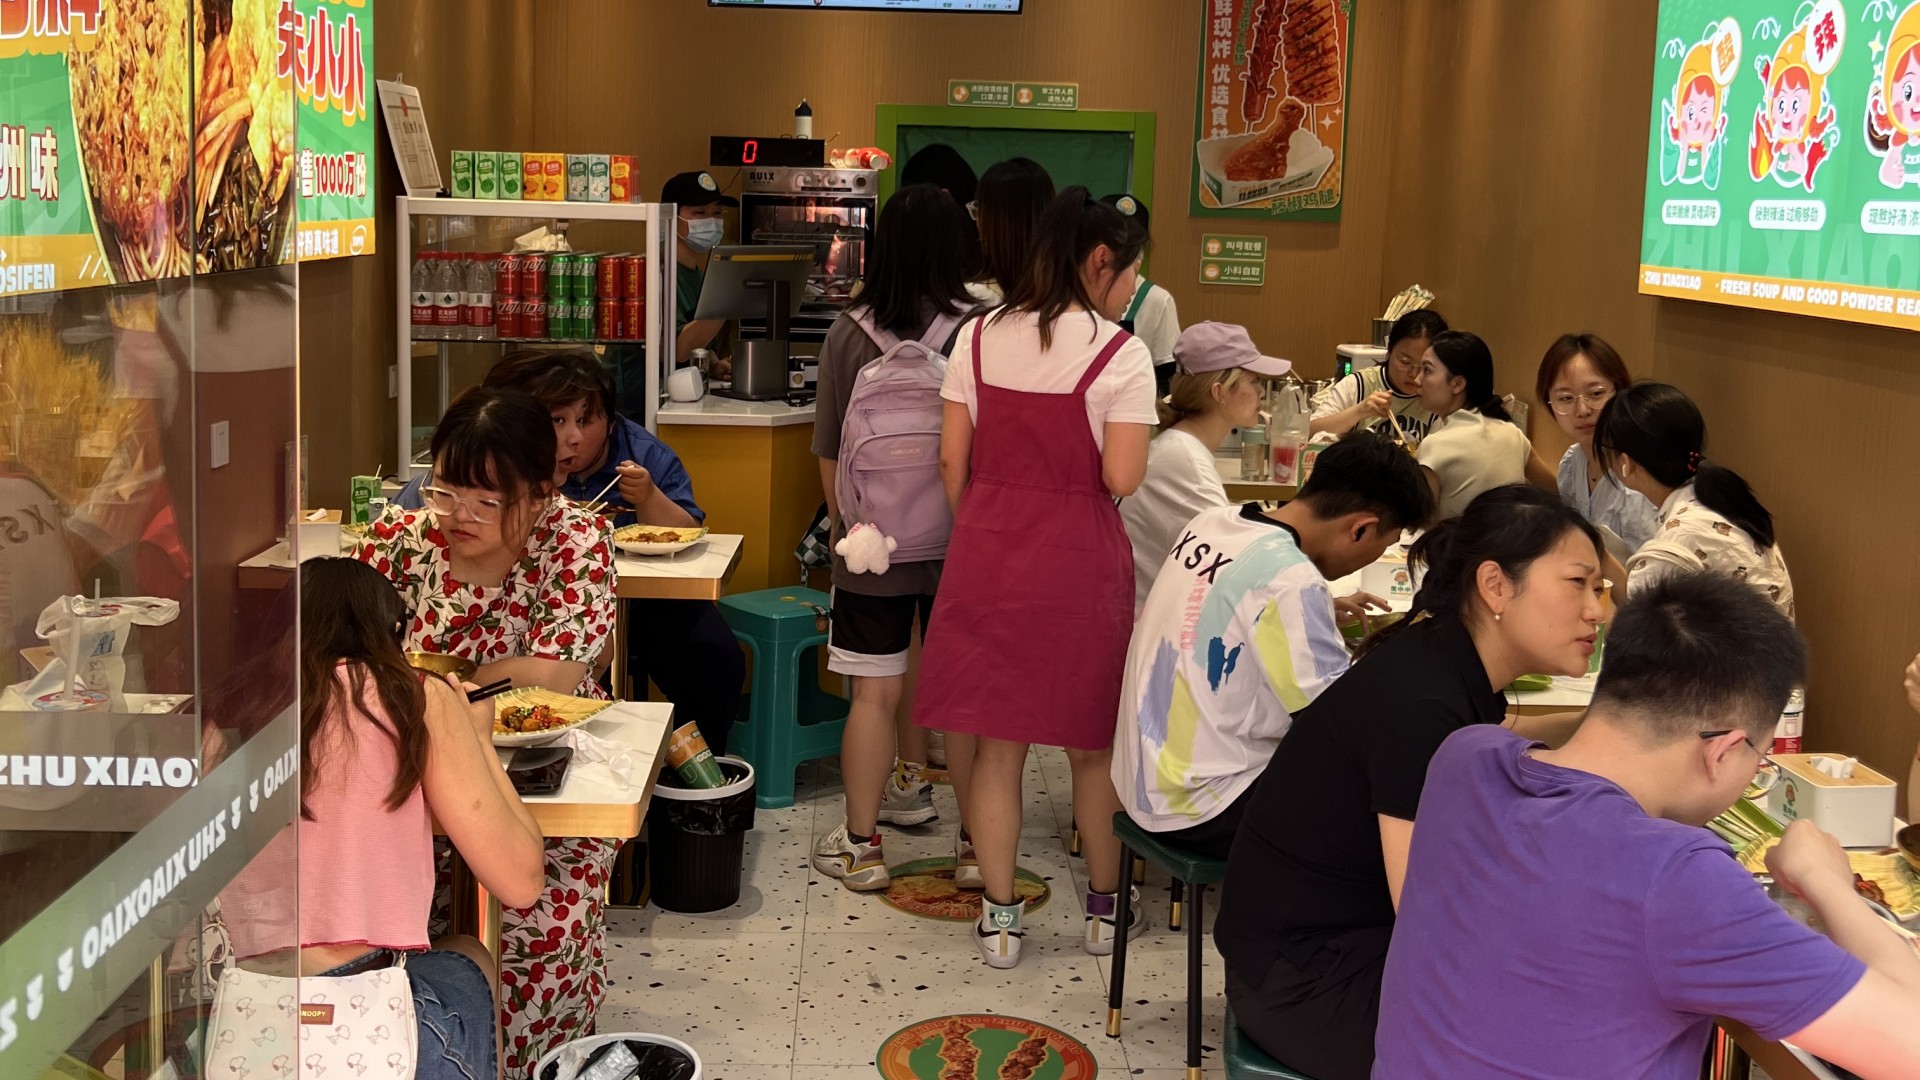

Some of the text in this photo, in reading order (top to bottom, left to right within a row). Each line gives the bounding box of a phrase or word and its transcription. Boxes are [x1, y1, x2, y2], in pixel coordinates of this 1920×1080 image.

[1813, 10, 1838, 63] 辣
[1042, 87, 1074, 96] 非工作人员
[742, 140, 758, 164] 0
[1868, 208, 1907, 226] 现熬好汤
[1226, 241, 1262, 251] 叫号取餐
[1224, 266, 1260, 276] 小料自取
[1720, 280, 1751, 297] FRESH
[1753, 283, 1780, 299] SOUP
[1781, 285, 1804, 302] AND
[1806, 287, 1838, 305] GOOD
[1840, 291, 1894, 313] POWDER
